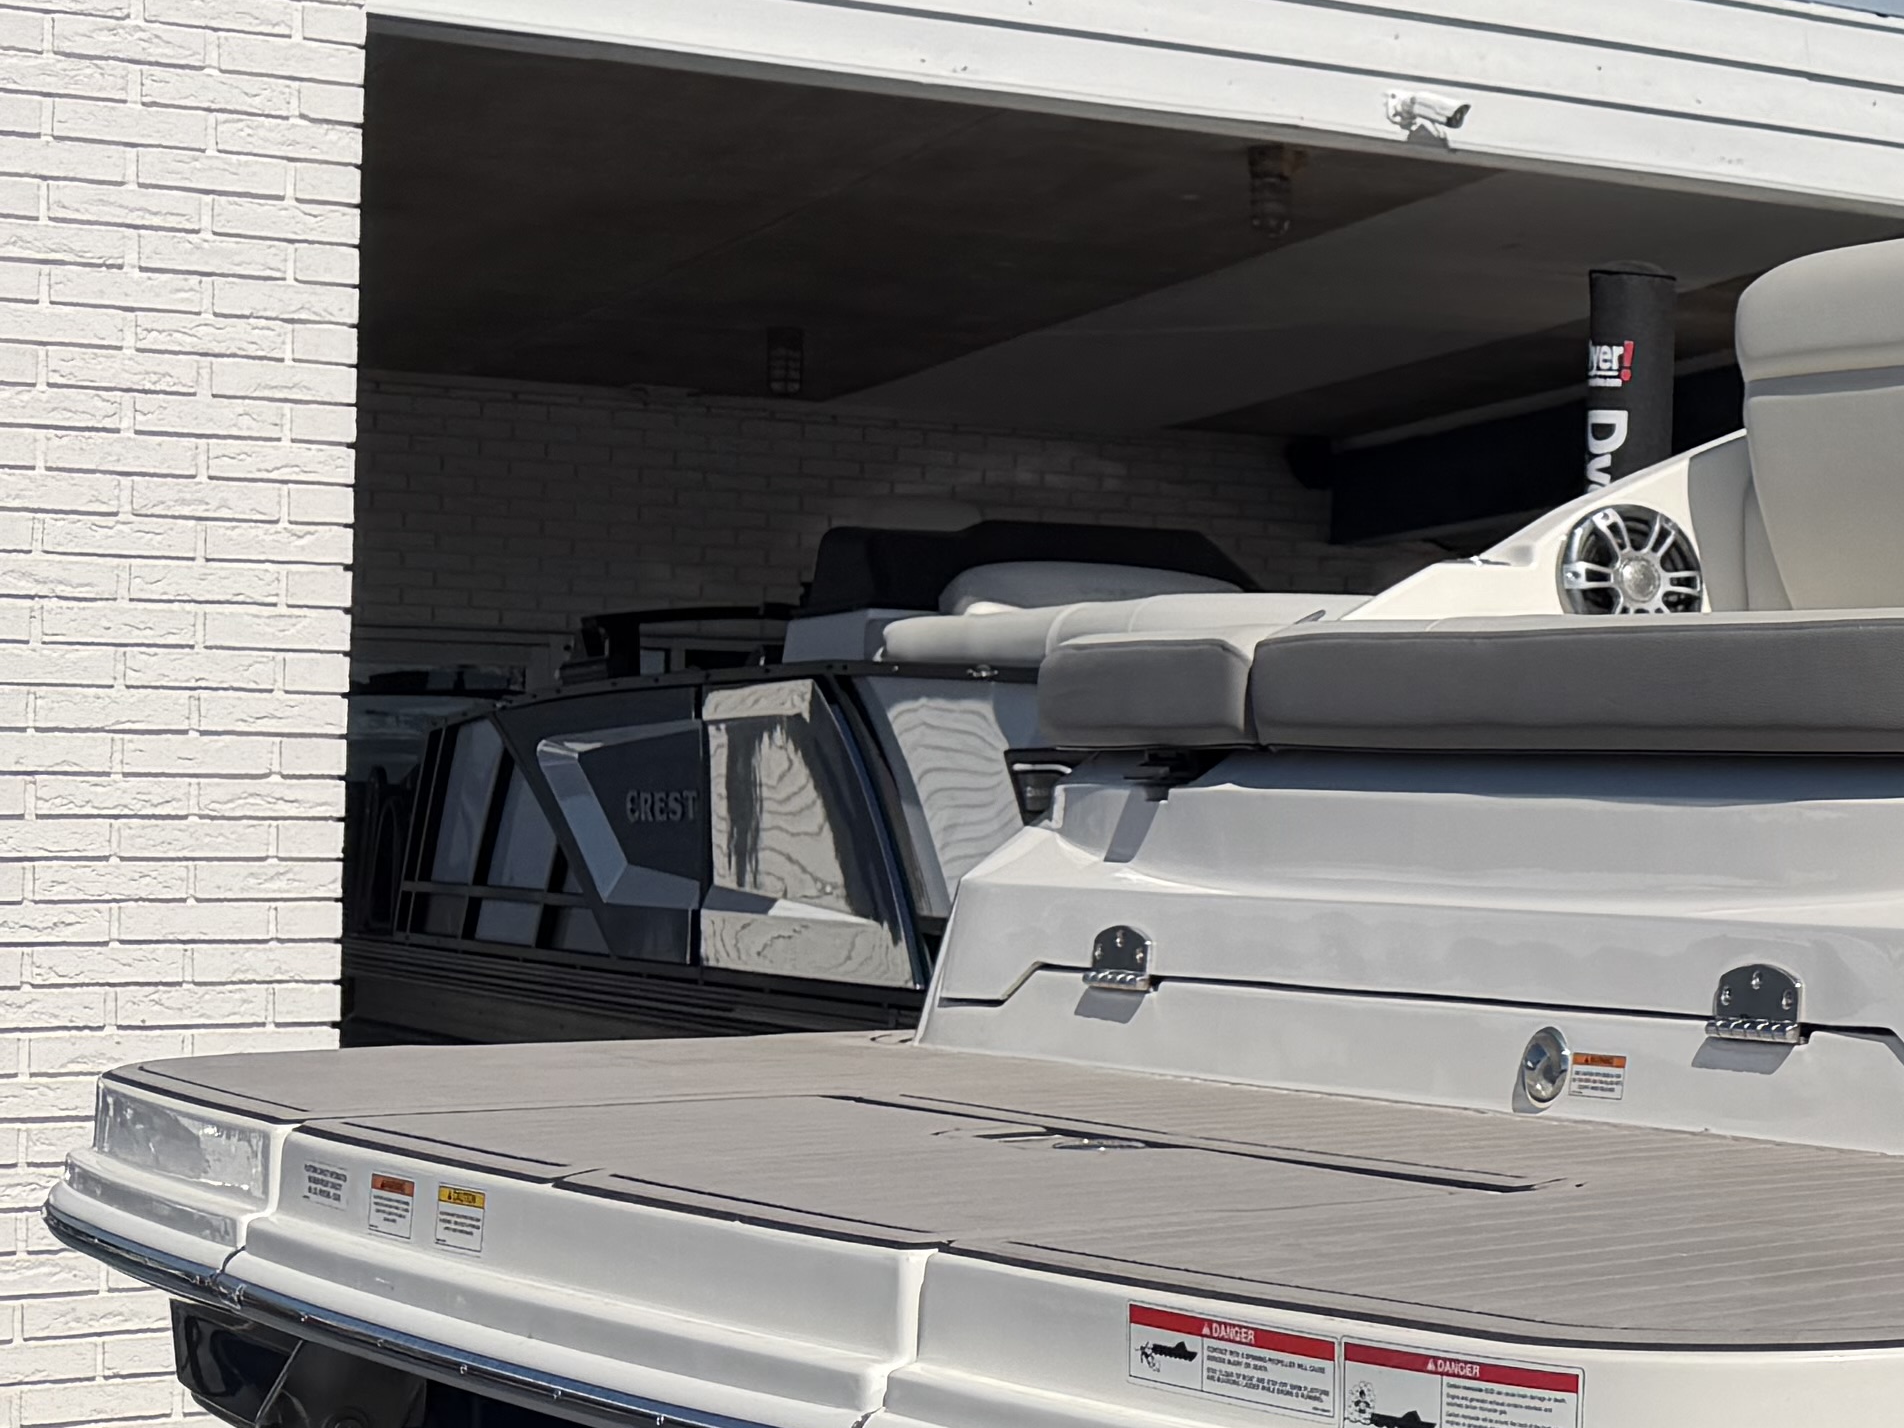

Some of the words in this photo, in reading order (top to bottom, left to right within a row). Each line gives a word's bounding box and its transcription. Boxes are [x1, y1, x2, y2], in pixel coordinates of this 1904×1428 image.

[625, 789, 698, 824] CREST
[1211, 1323, 1256, 1345] DANGER
[1436, 1358, 1480, 1377] DANGER
